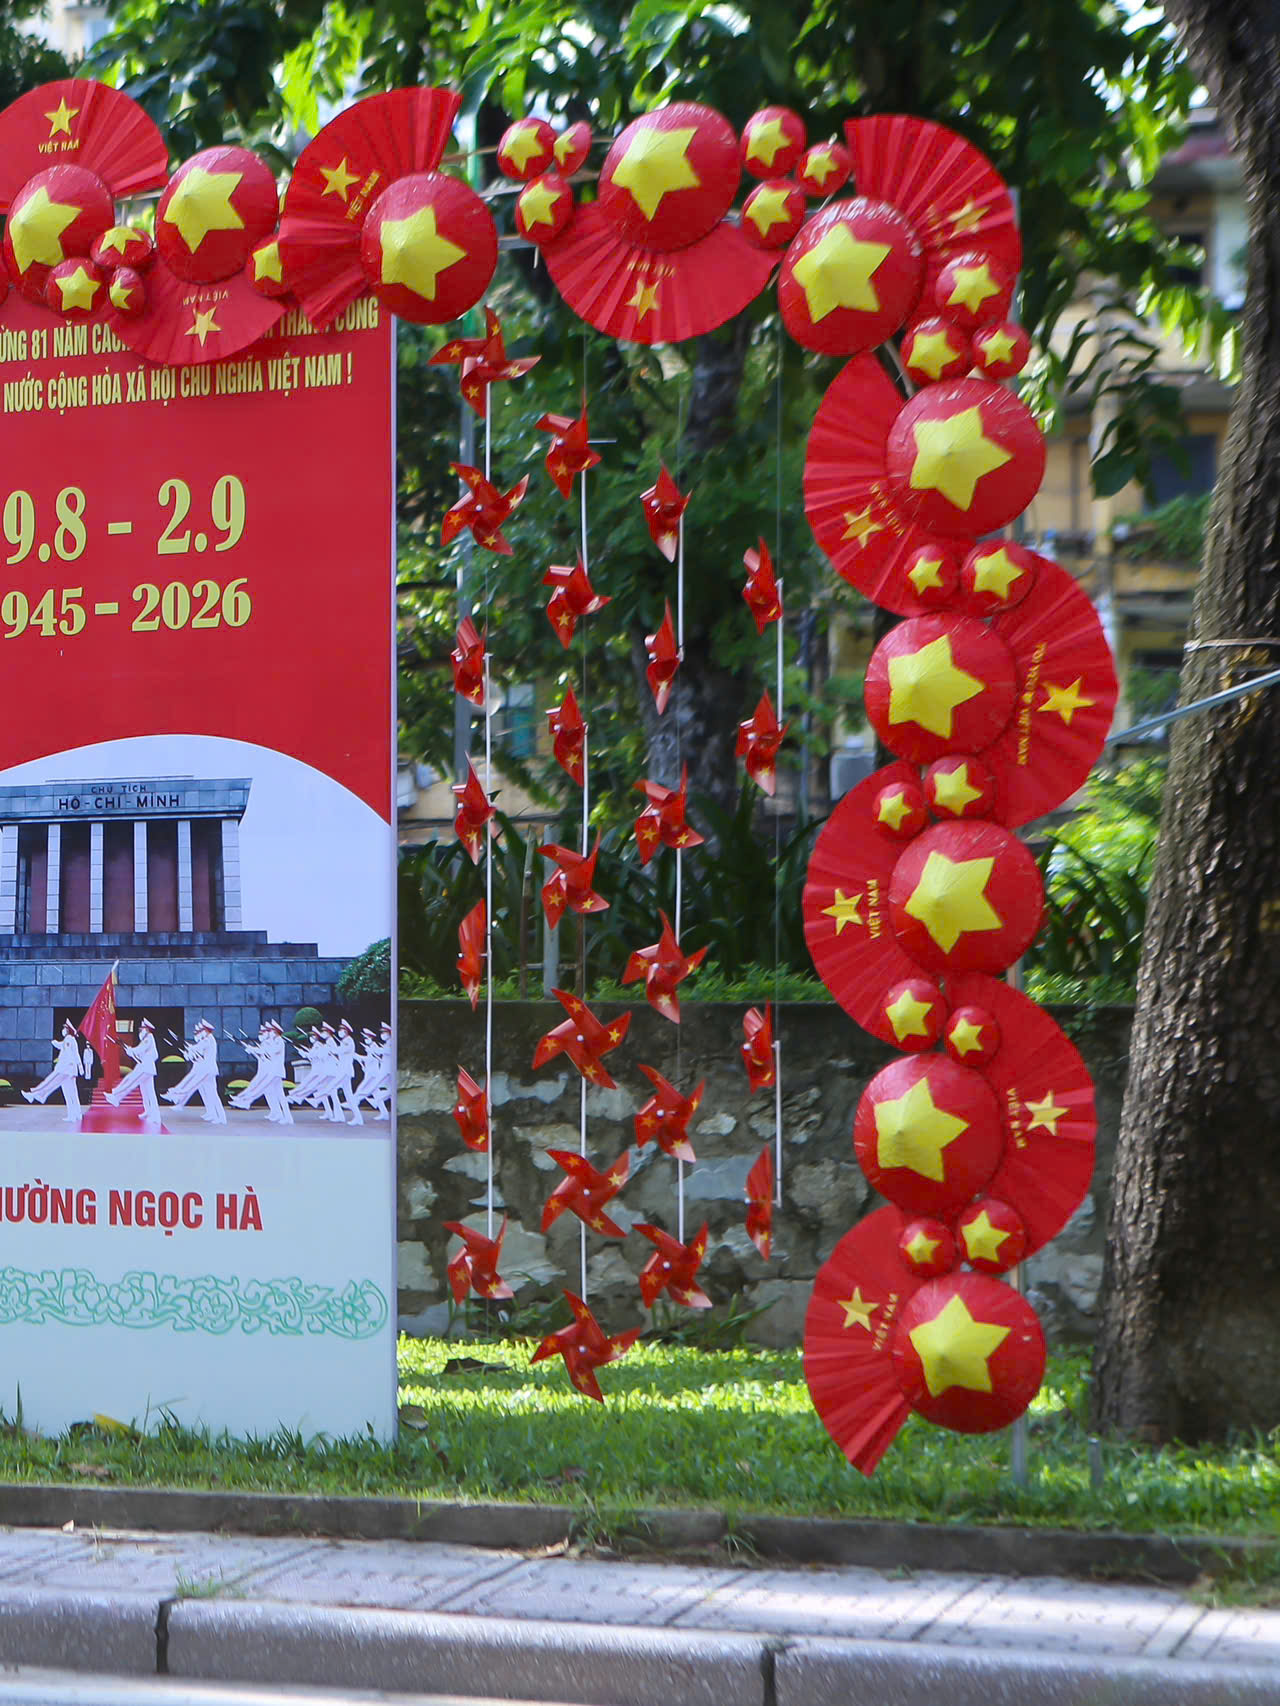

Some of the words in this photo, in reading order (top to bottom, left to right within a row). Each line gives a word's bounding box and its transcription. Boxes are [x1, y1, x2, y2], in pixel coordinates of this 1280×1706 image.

[31, 328, 47, 360] 81
[53, 320, 87, 358] NĂM
[4, 371, 43, 413] NƯỚC
[47, 371, 87, 415] CỘNG
[92, 367, 121, 405] HÒA
[126, 365, 147, 403] XÃ
[151, 363, 176, 406] HỘI
[216, 355, 263, 395] NGHĨA
[268, 351, 301, 397] VIỆT
[305, 353, 342, 389] NAM
[157, 474, 246, 555] 2.9
[131, 577, 252, 632] 2026
[866, 880, 880, 906] NAM
[109, 1190, 203, 1236] NGỌC
[216, 1186, 264, 1231] HÀ
